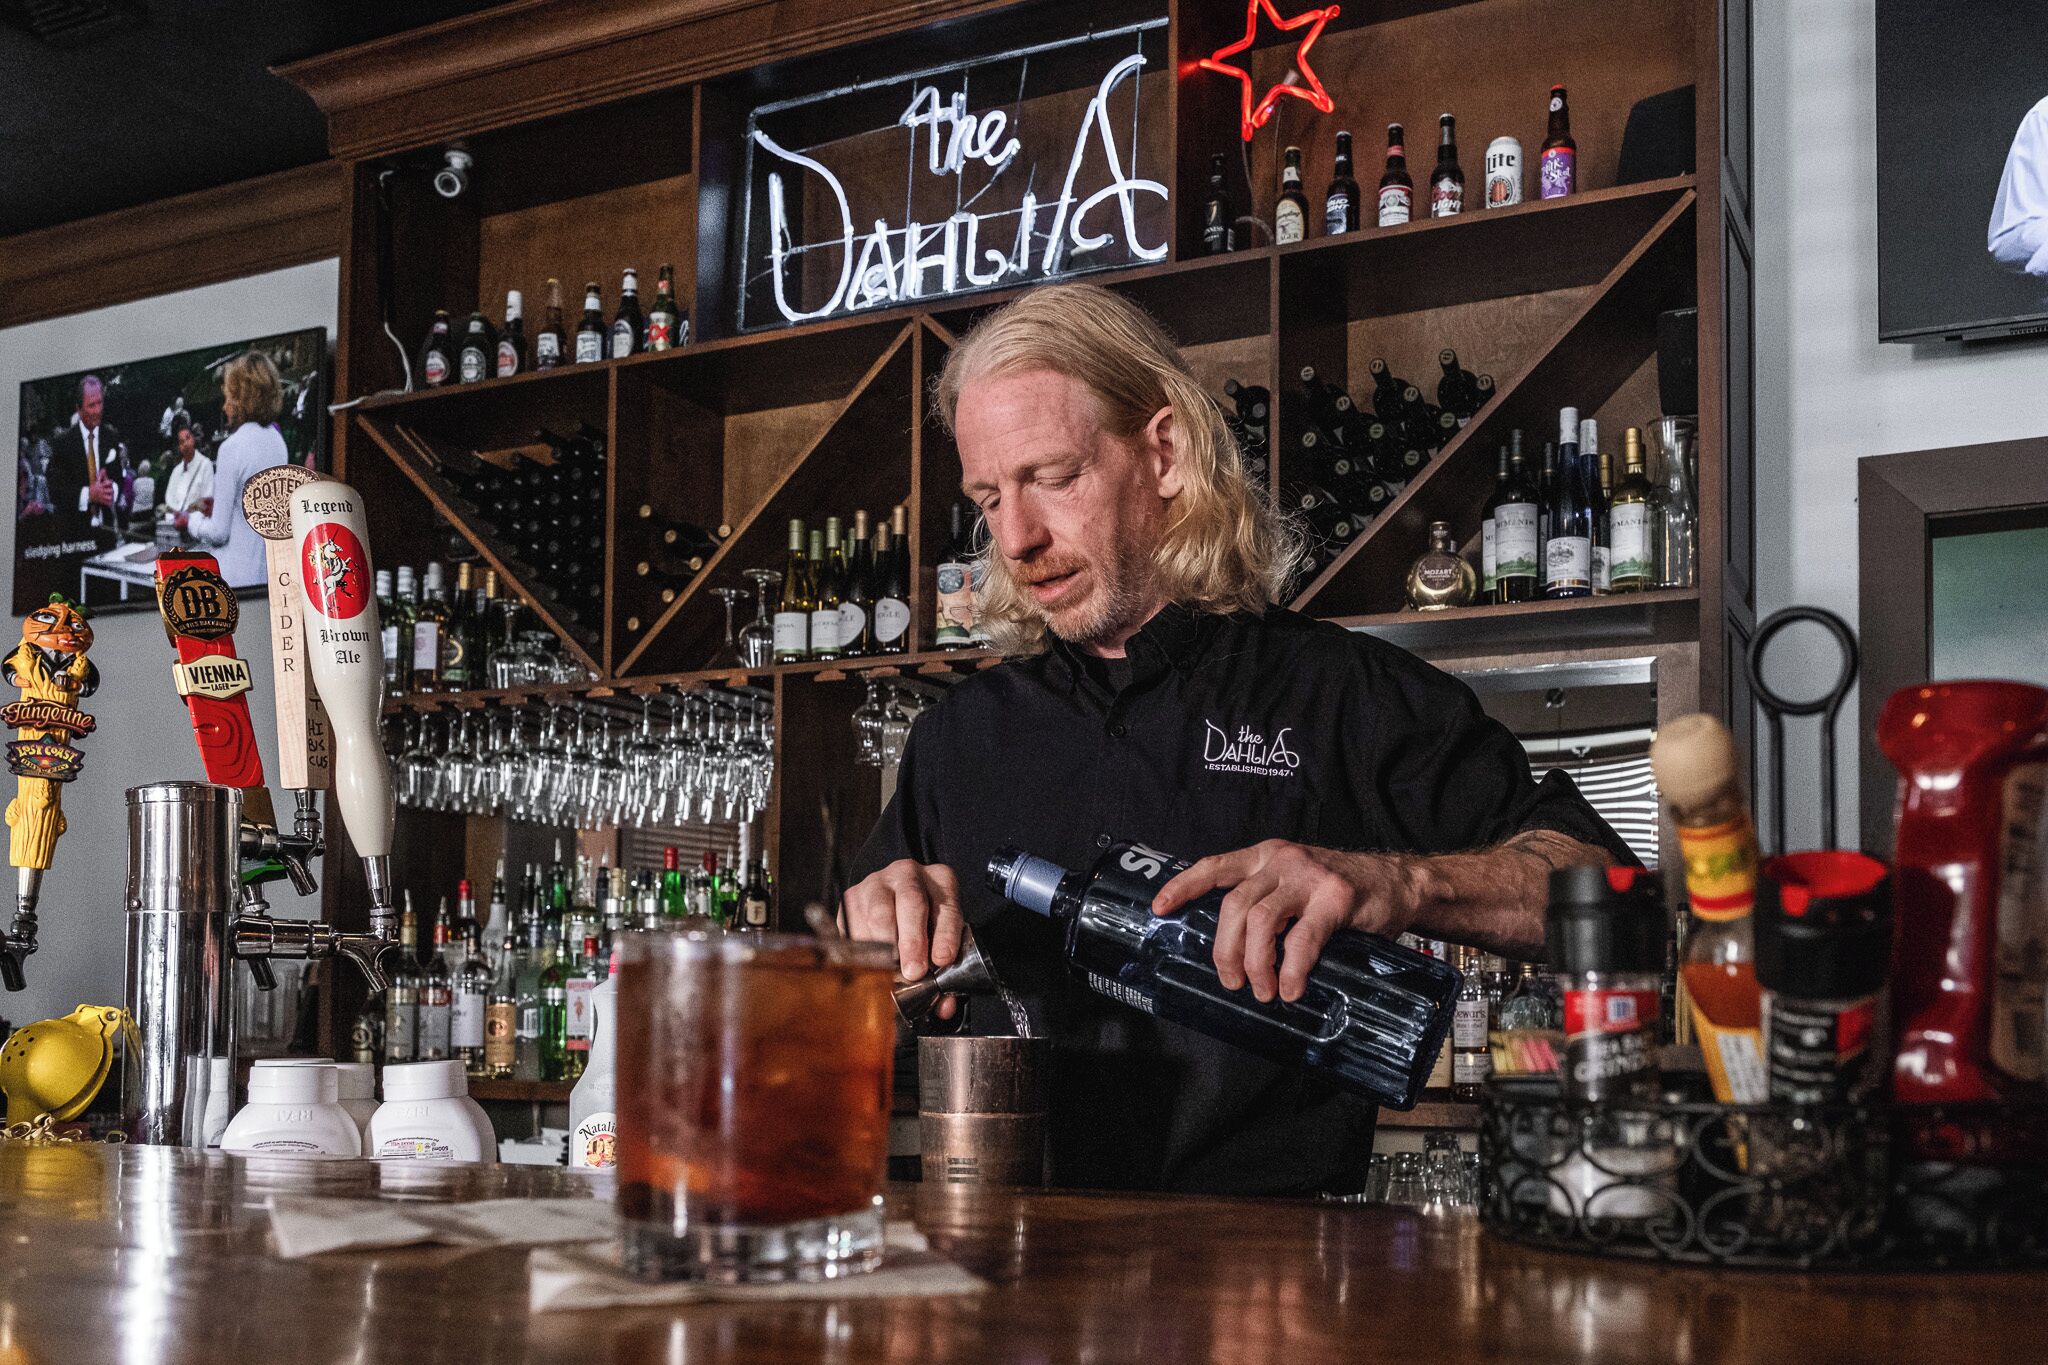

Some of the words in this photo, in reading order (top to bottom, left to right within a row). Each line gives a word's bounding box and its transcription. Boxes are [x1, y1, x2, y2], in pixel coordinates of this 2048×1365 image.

[901, 86, 1020, 175] the
[1487, 153, 1516, 174] Lite
[252, 478, 304, 510] POTTER
[301, 499, 353, 515] Legend
[253, 520, 277, 530] CRAFT
[180, 585, 221, 618] DB
[278, 572, 295, 673] CIDER
[320, 629, 370, 645] Brown
[335, 650, 361, 665] Ale
[189, 663, 247, 685] VIENNA
[210, 682, 230, 692] LAGER
[1, 698, 92, 728] Tangerine
[1203, 719, 1300, 768] DAHLIA
[1238, 724, 1264, 744] the
[16, 744, 43, 758] LOST
[44, 745, 79, 763] COAST
[1208, 763, 1268, 776] ESTABLISHED
[1268, 768, 1291, 777] 1947
[1119, 842, 1174, 880] SK
[578, 1121, 617, 1141] Natali
